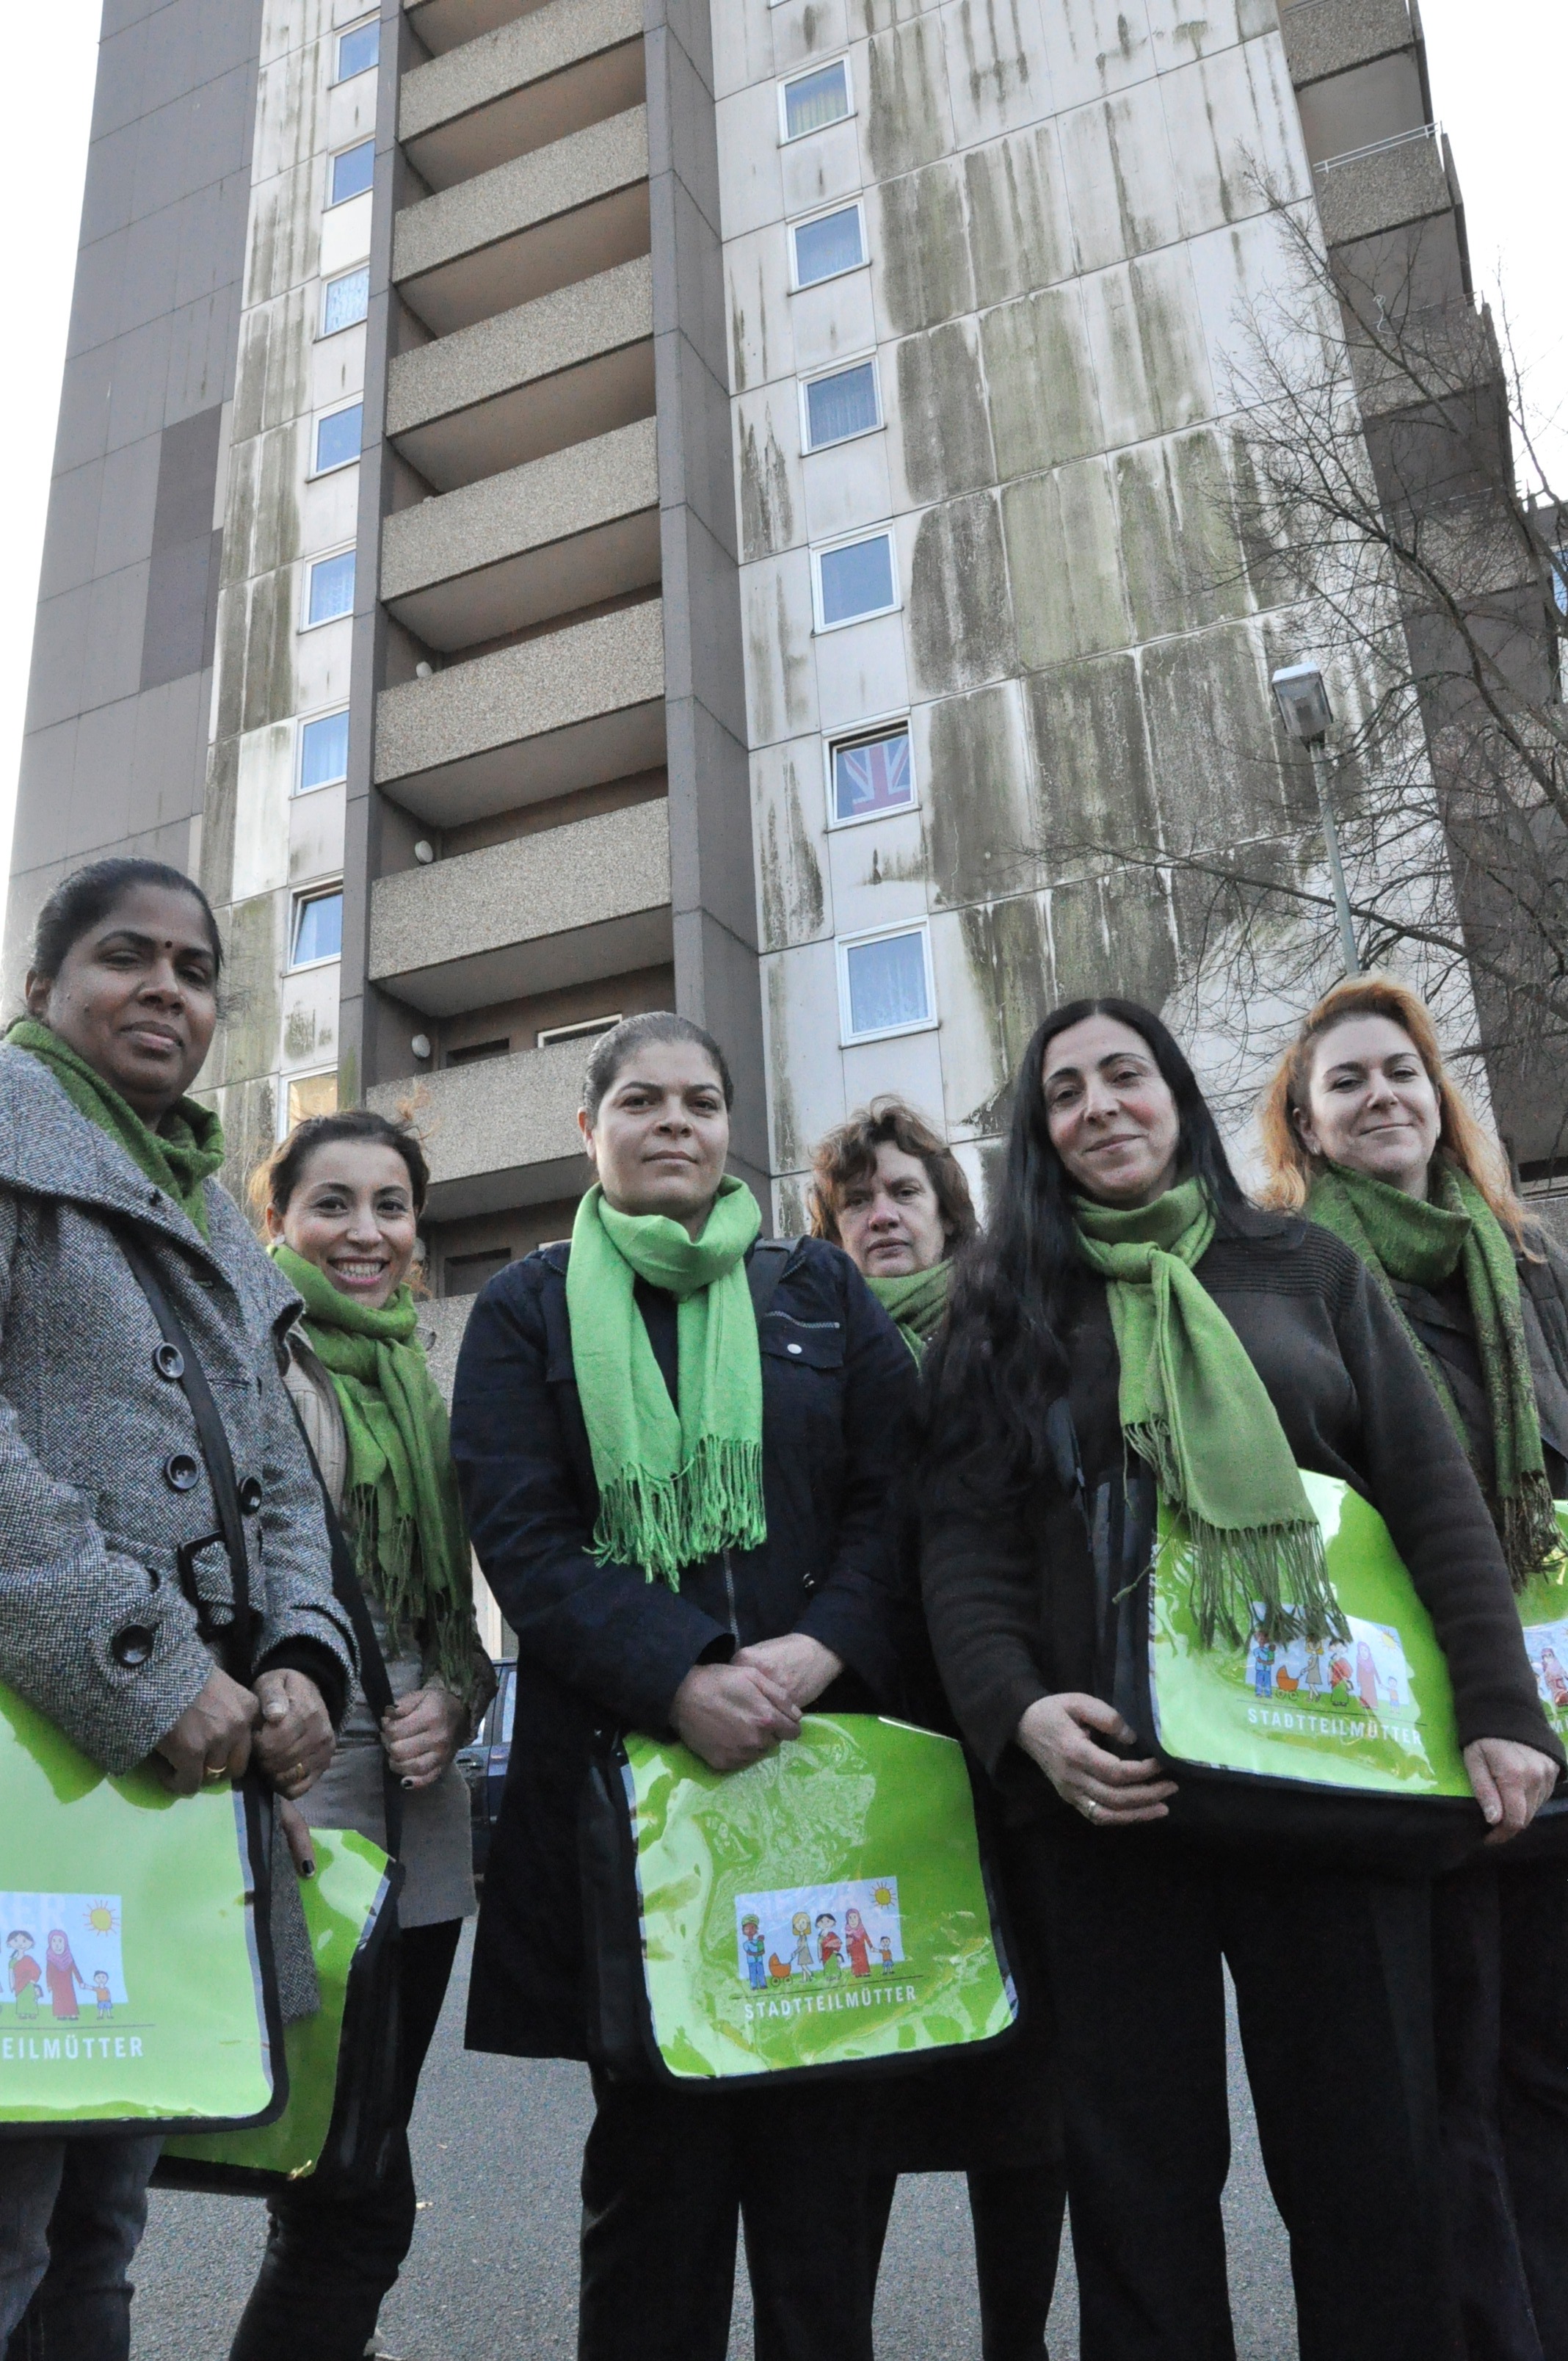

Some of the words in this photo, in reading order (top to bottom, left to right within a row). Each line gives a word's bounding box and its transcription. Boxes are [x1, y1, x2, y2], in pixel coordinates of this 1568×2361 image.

[1248, 1708, 1421, 1745] STADTTEILMÜTTER
[744, 1985, 917, 2019] STADTTEILMÜTTER
[2, 2034, 143, 2059] EILMÜTTER
